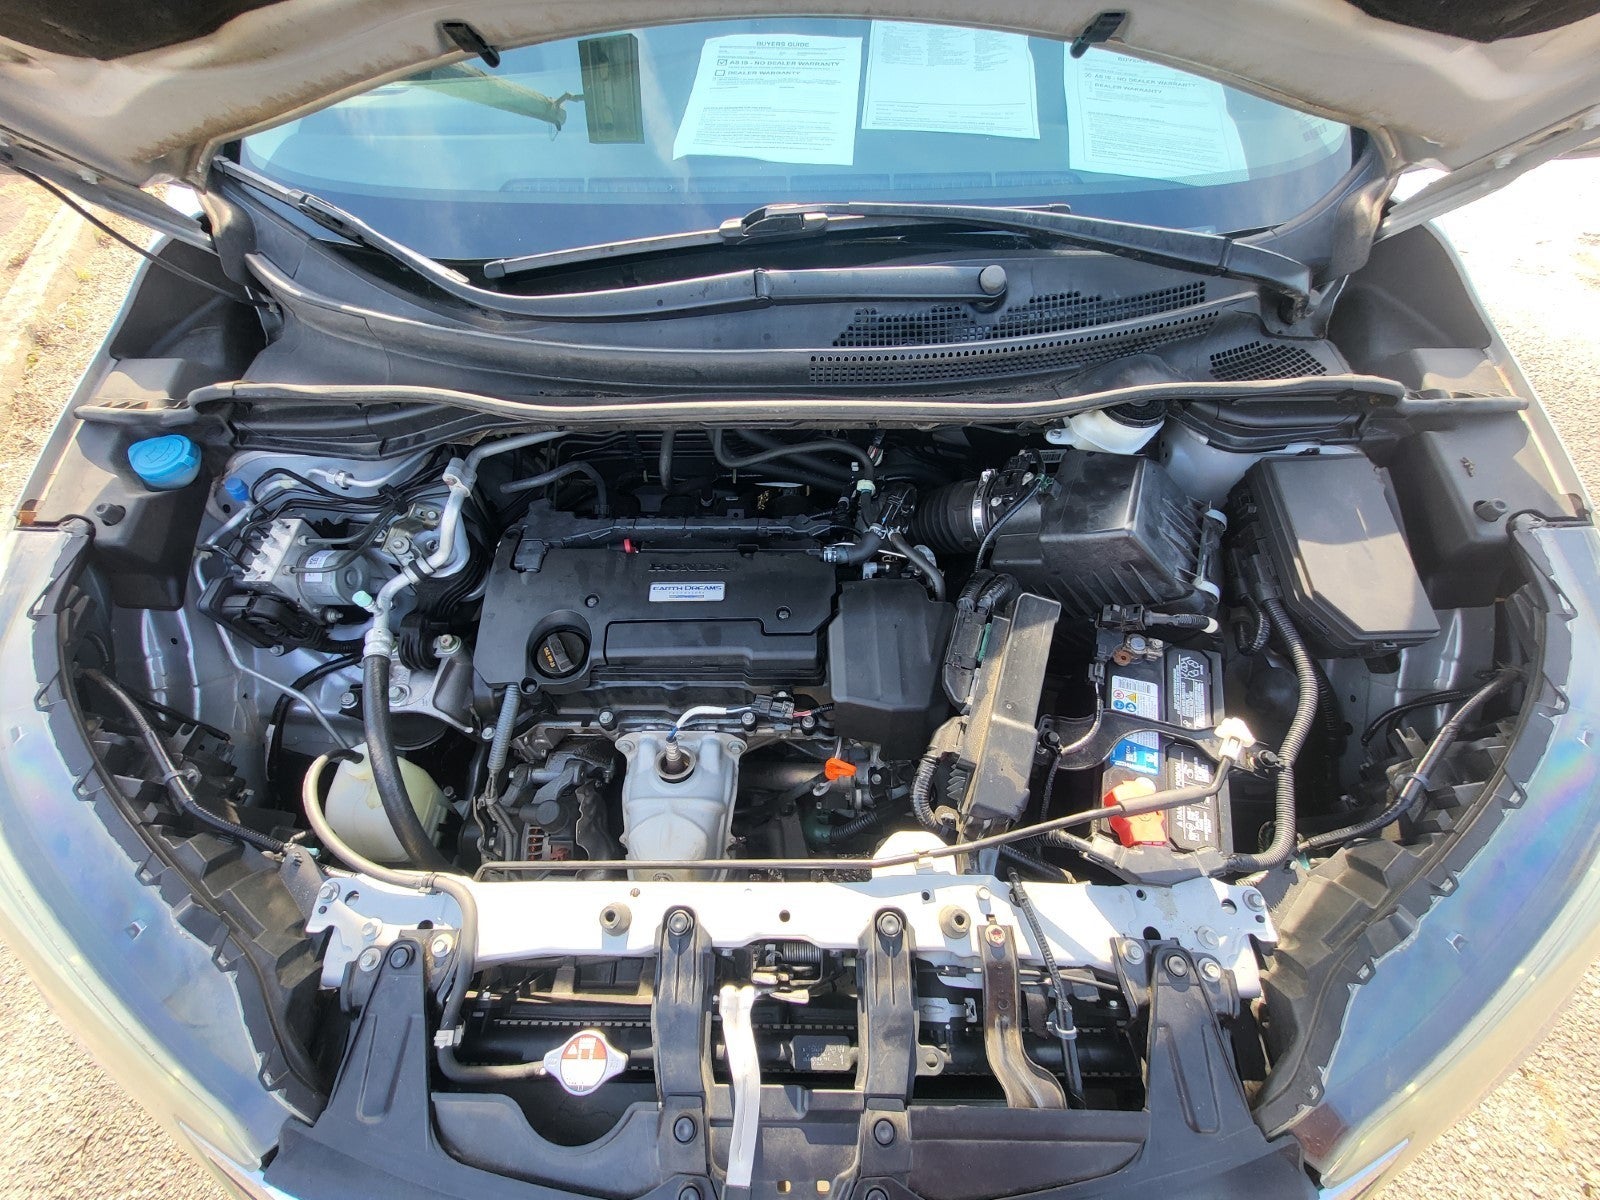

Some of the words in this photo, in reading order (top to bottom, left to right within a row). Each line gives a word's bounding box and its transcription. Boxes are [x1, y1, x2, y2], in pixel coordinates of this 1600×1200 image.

[1158, 80, 1197, 88] WARRANTY
[1123, 86, 1162, 94] WARRANTY
[648, 563, 731, 572] HONDA
